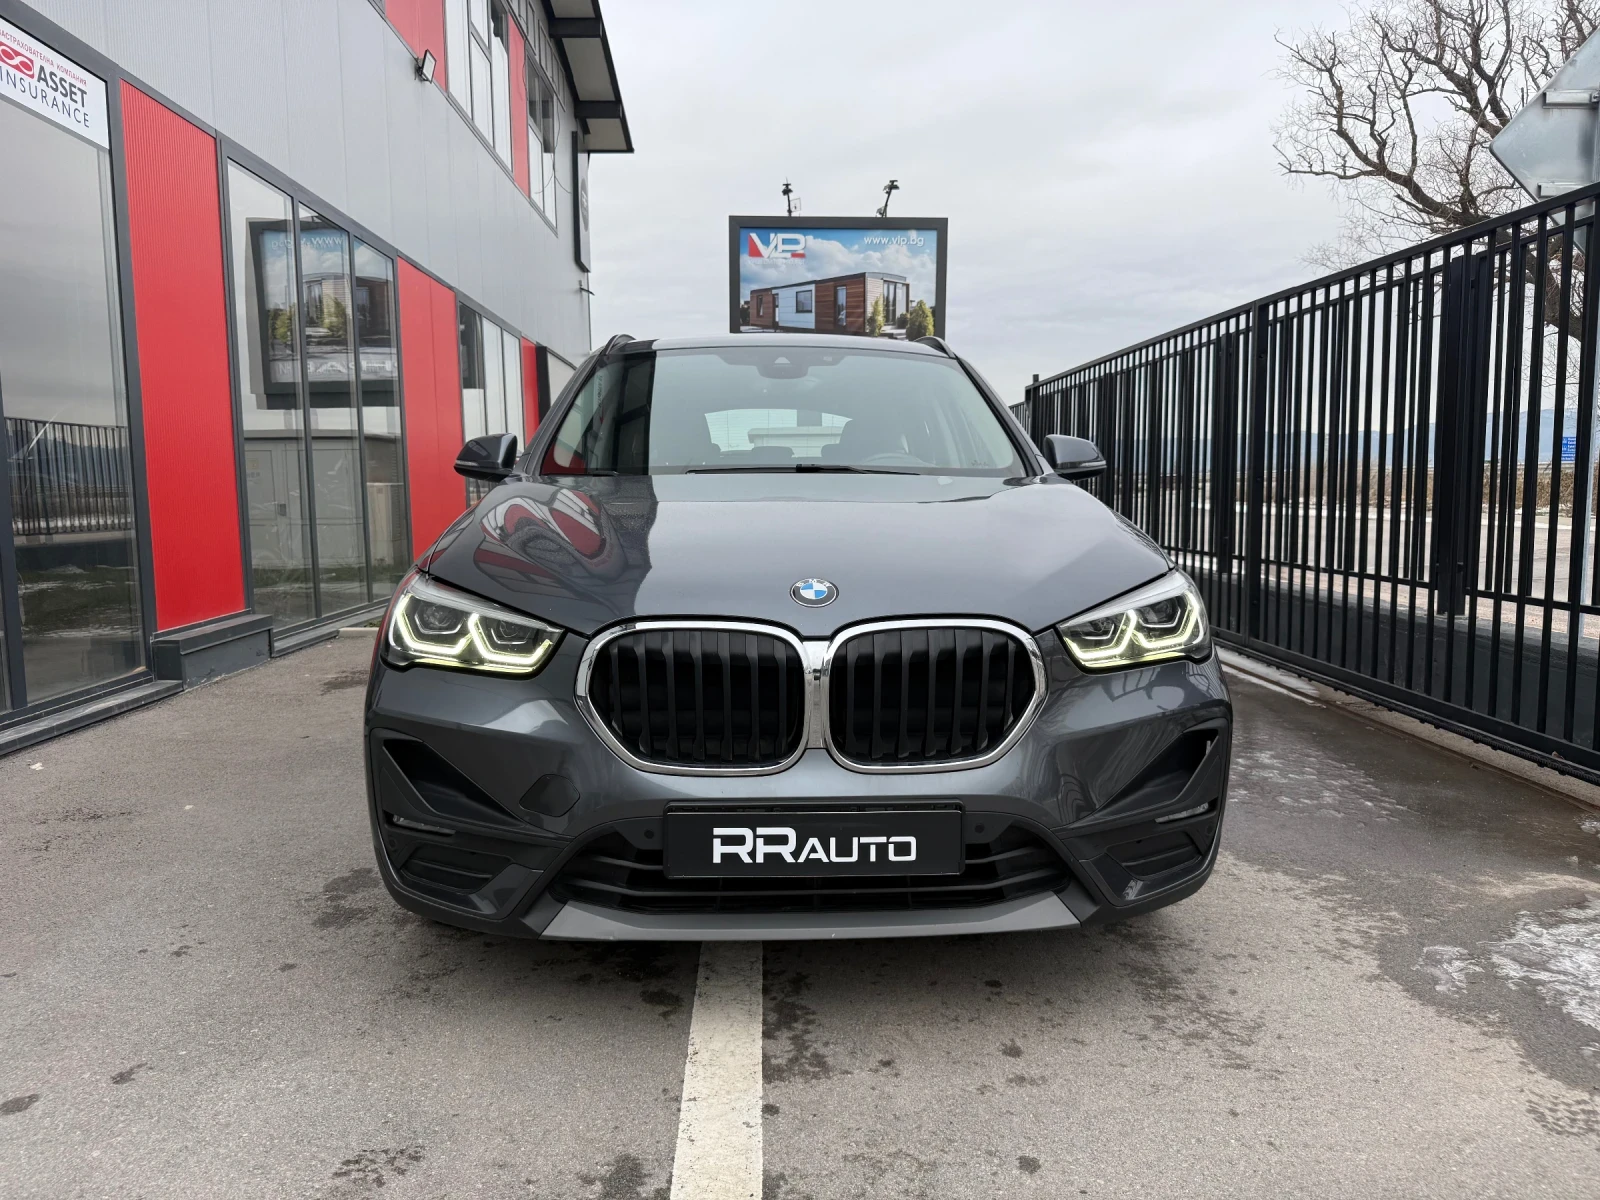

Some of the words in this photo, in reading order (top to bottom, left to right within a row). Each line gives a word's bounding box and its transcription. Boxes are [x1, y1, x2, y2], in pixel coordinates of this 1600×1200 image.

[37, 64, 87, 108] ASSET
[57, 63, 87, 86] КОМПАНИЯ
[0, 65, 90, 128] INSURANCE
[863, 235, 925, 247] www.vip.bg
